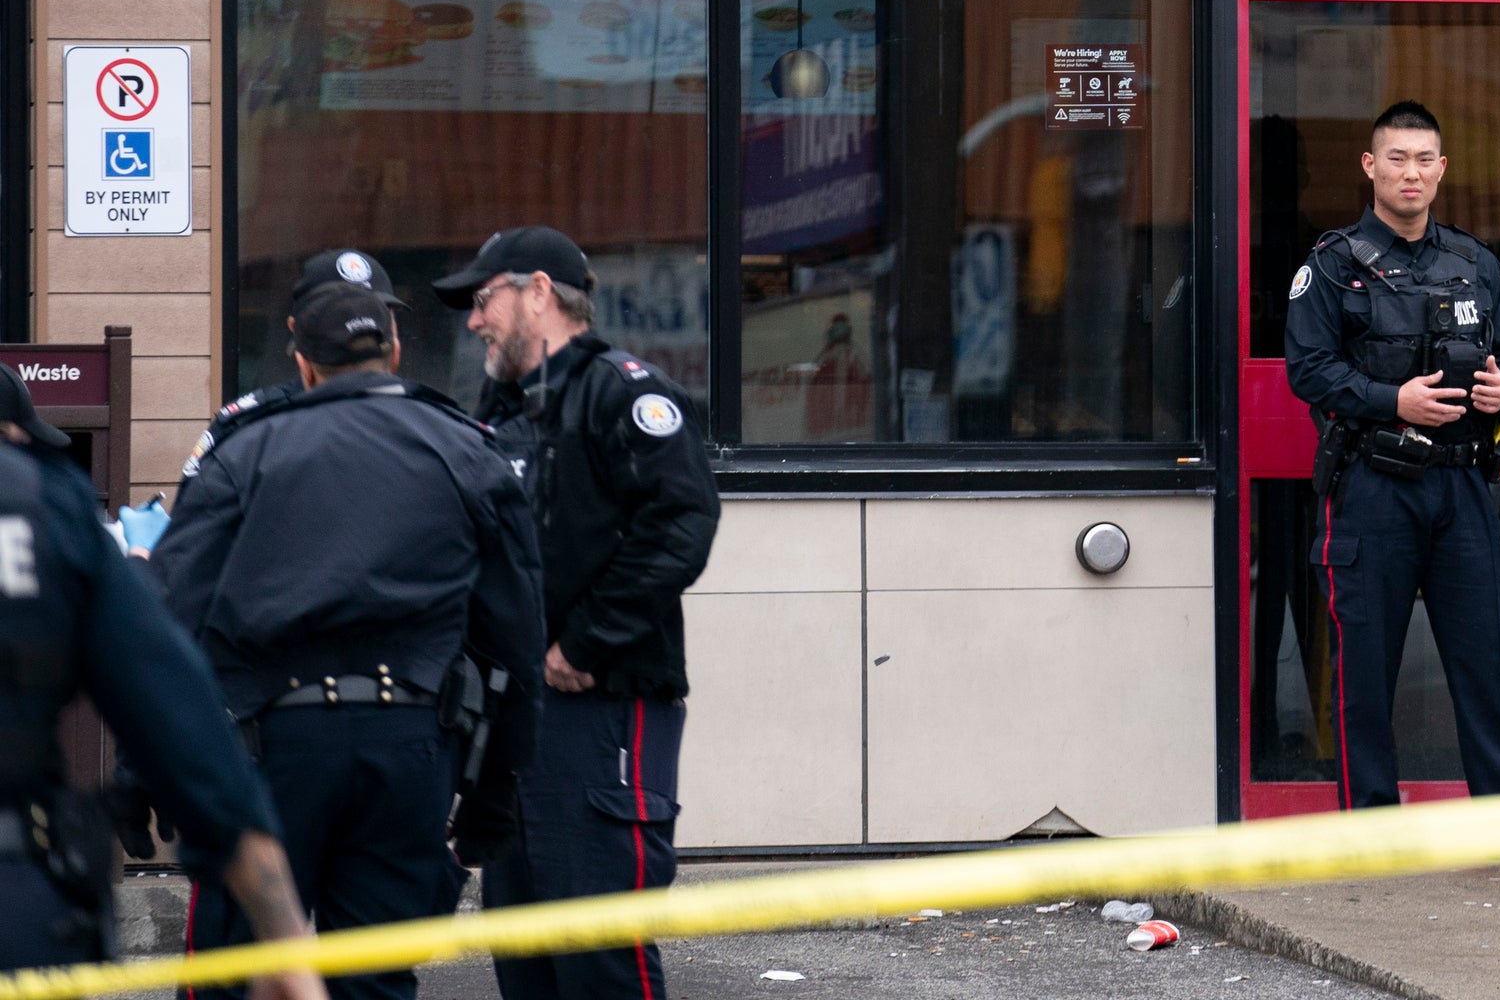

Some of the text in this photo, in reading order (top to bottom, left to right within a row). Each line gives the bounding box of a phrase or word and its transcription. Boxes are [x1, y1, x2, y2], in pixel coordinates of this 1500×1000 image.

[1076, 49, 1102, 58] Hiring!
[85, 191, 171, 205] BY PERMIT
[107, 207, 149, 221] ONLY
[18, 363, 81, 381] Waste
